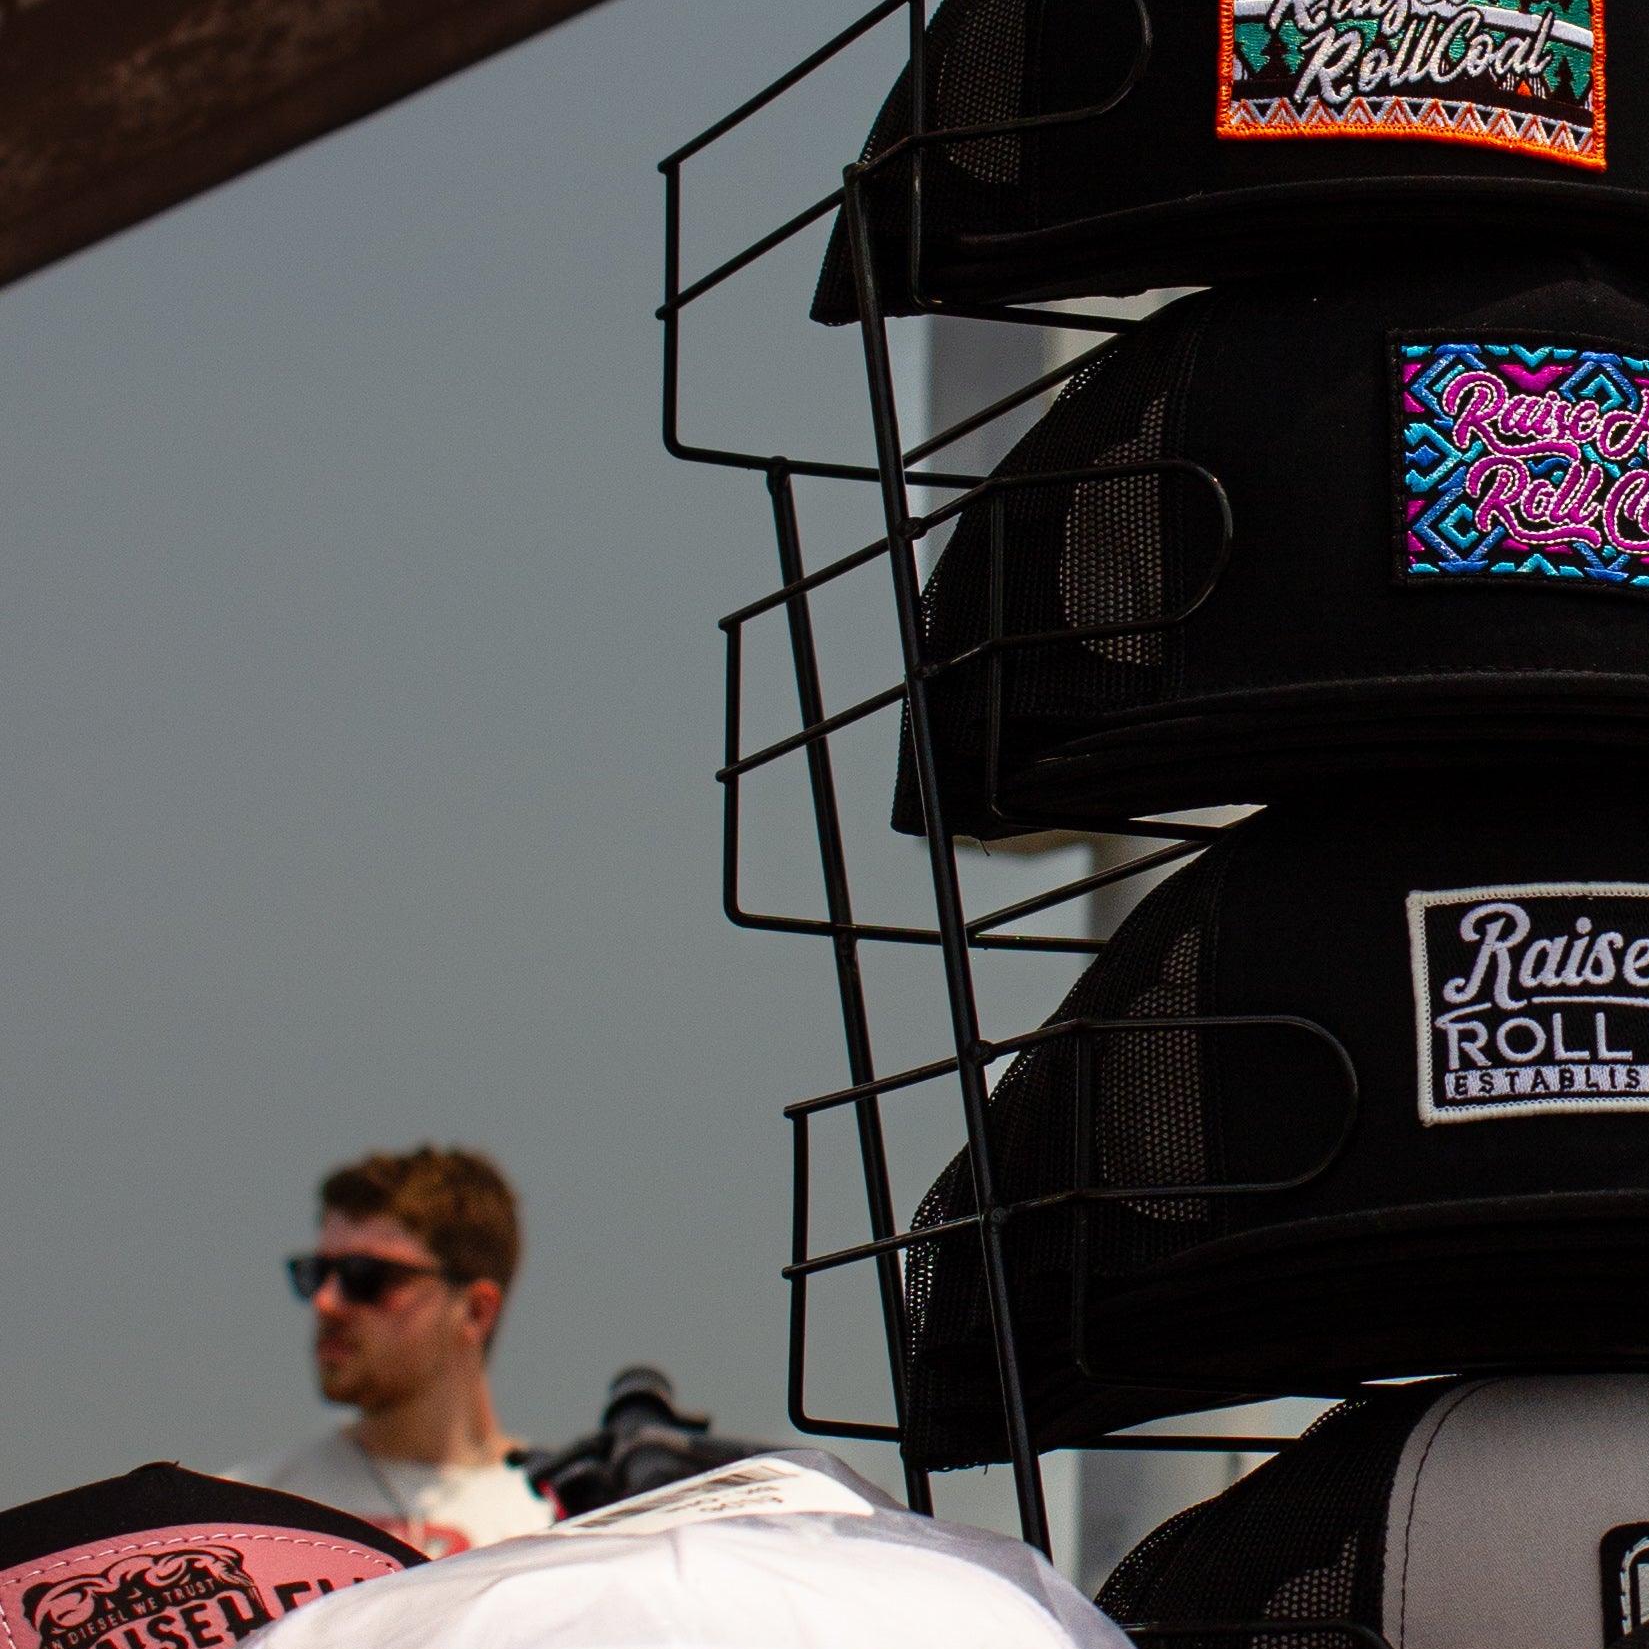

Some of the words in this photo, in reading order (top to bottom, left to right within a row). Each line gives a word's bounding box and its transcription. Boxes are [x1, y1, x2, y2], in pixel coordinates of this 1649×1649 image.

[1444, 370, 1602, 463] Raise
[1466, 454, 1603, 549] Roll
[1445, 1011, 1634, 1070] ROLL
[67, 1611, 129, 1644] DIESEL
[131, 1596, 159, 1616] WE
[164, 1577, 217, 1604] TRUST
